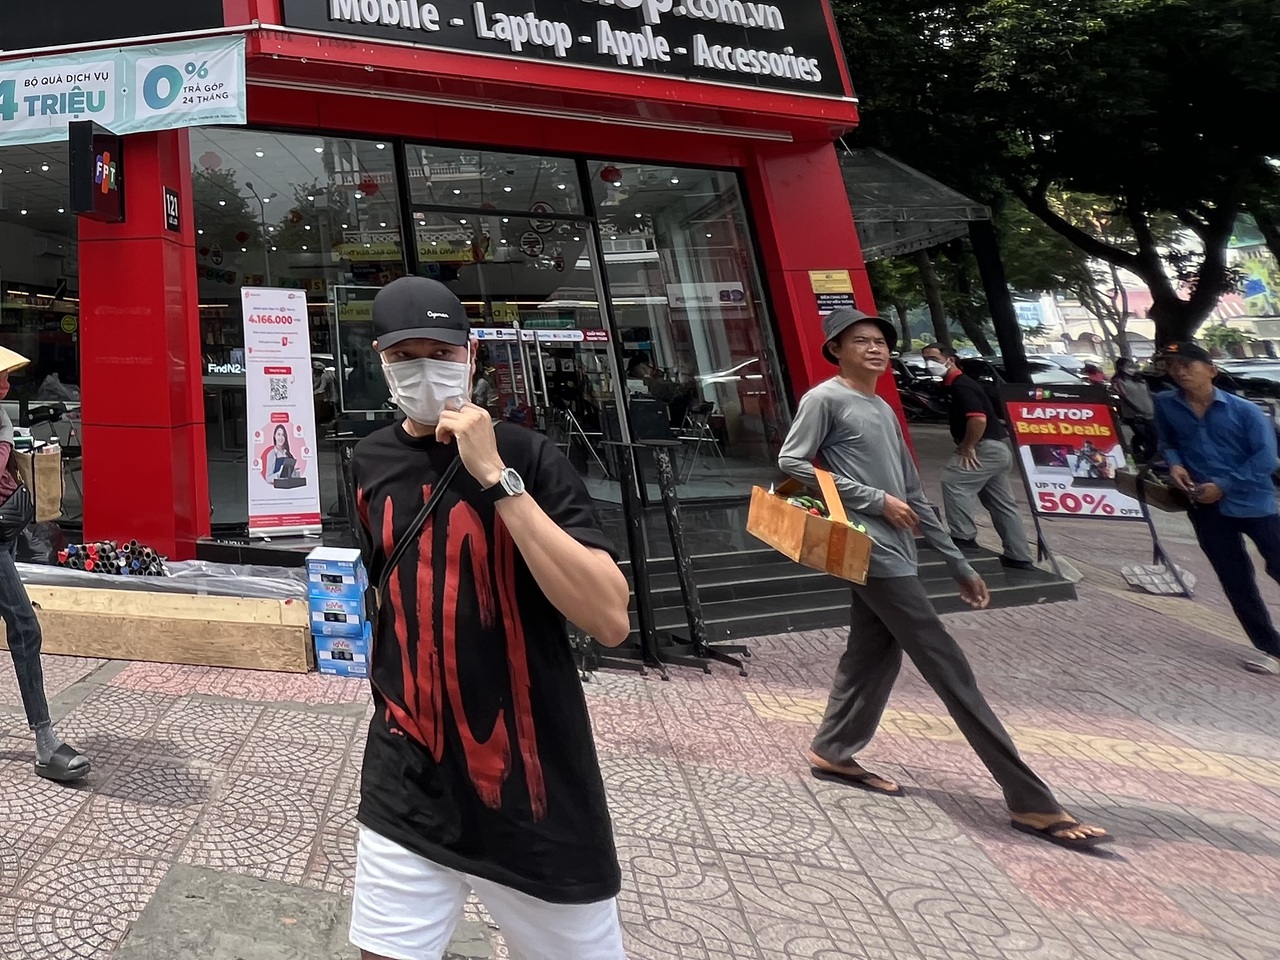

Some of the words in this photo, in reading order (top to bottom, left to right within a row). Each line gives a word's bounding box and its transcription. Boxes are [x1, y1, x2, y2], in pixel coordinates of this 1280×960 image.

[472, 2, 572, 58] Laptop
[596, 19, 672, 67] Apple
[692, 33, 822, 83] Accessories
[24, 76, 39, 88] BỘ
[41, 73, 63, 86] QUÀ
[66, 73, 91, 85] DỊCH
[94, 71, 109, 83] VỤ
[204, 82, 224, 92] GÓP
[23, 85, 106, 119] TRIỆU
[182, 96, 194, 104] 24
[196, 92, 229, 104] THÁNG
[96, 161, 116, 183] FPT
[166, 193, 178, 217] 121
[248, 314, 293, 325] 4.166.000
[1022, 407, 1094, 420] LAPTOP
[1016, 421, 1057, 434] Best
[1058, 421, 1111, 436] Deals
[1038, 492, 1115, 515] 50%
